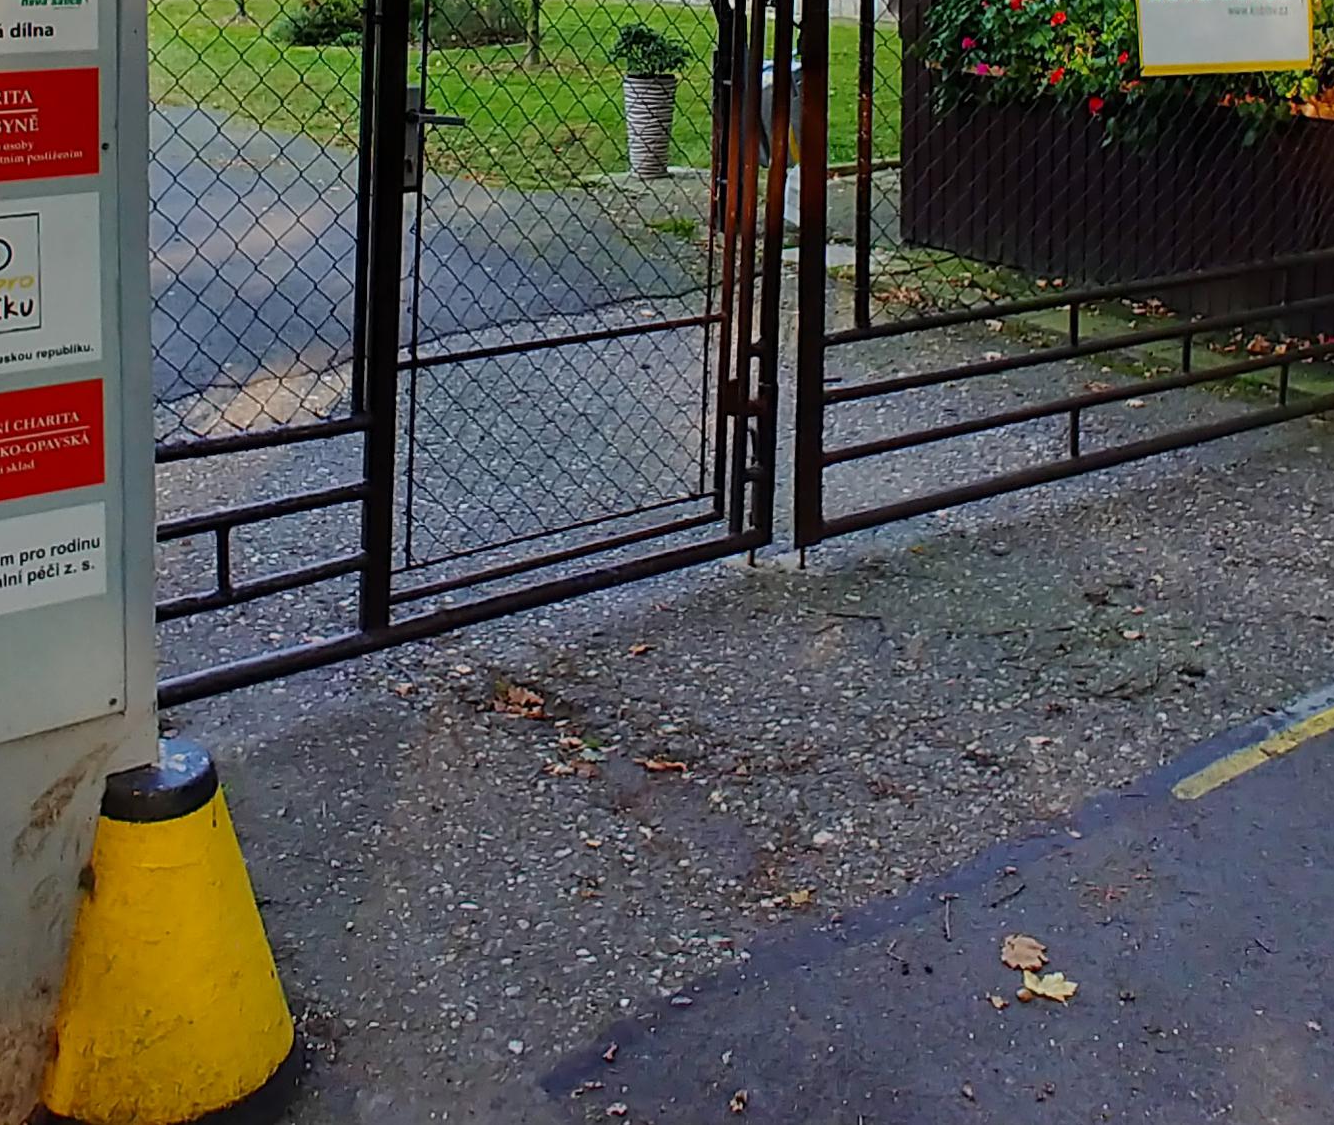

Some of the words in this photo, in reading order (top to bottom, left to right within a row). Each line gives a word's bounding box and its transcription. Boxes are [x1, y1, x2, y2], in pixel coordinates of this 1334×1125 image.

[9, 22, 55, 38] dílna
[3, 139, 34, 152] osoby
[36, 343, 95, 360] republiku.
[13, 411, 80, 431] CHARITA
[6, 459, 35, 473] sklad
[19, 547, 46, 566] pro
[50, 537, 101, 557] rodinu
[27, 562, 60, 586] péči
[63, 564, 77, 575] z.
[81, 559, 95, 572] s.
